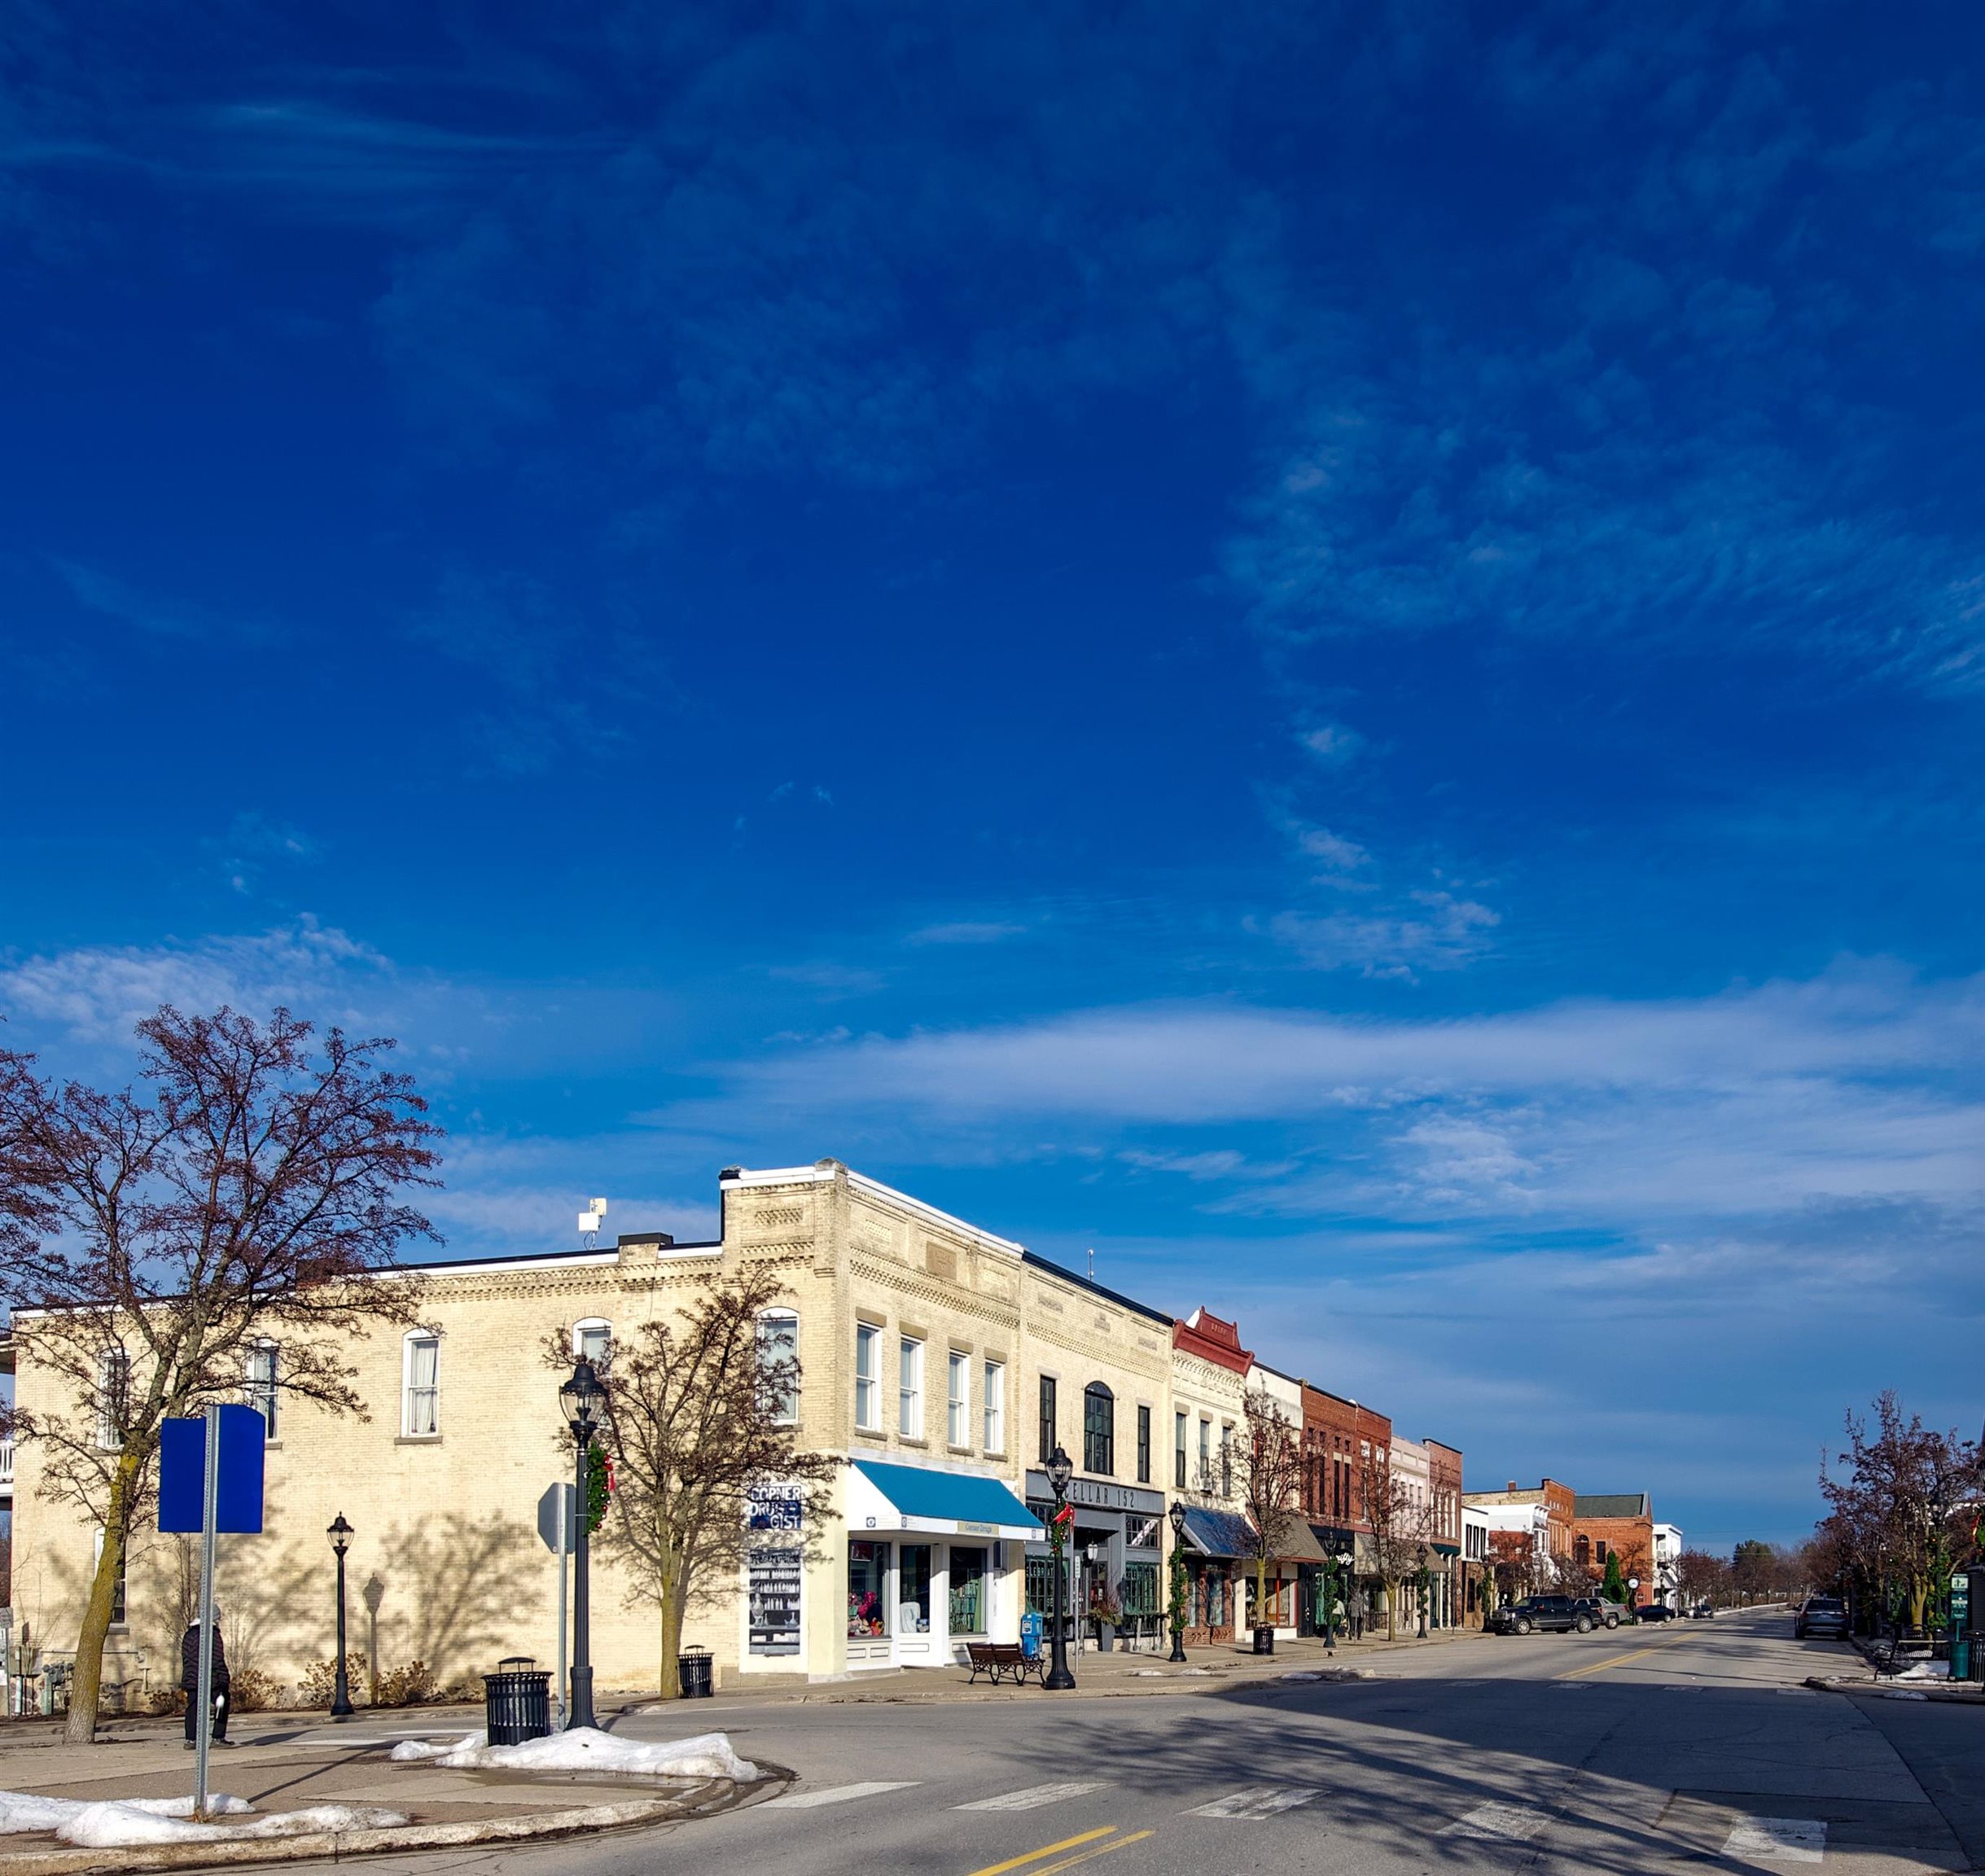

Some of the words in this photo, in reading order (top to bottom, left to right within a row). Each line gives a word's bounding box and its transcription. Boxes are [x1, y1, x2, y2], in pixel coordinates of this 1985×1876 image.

[751, 1487, 800, 1501] CORNER
[1064, 1482, 1108, 1505] CELLAR
[1117, 1489, 1134, 1508] 152
[770, 1514, 800, 1529] GIST
